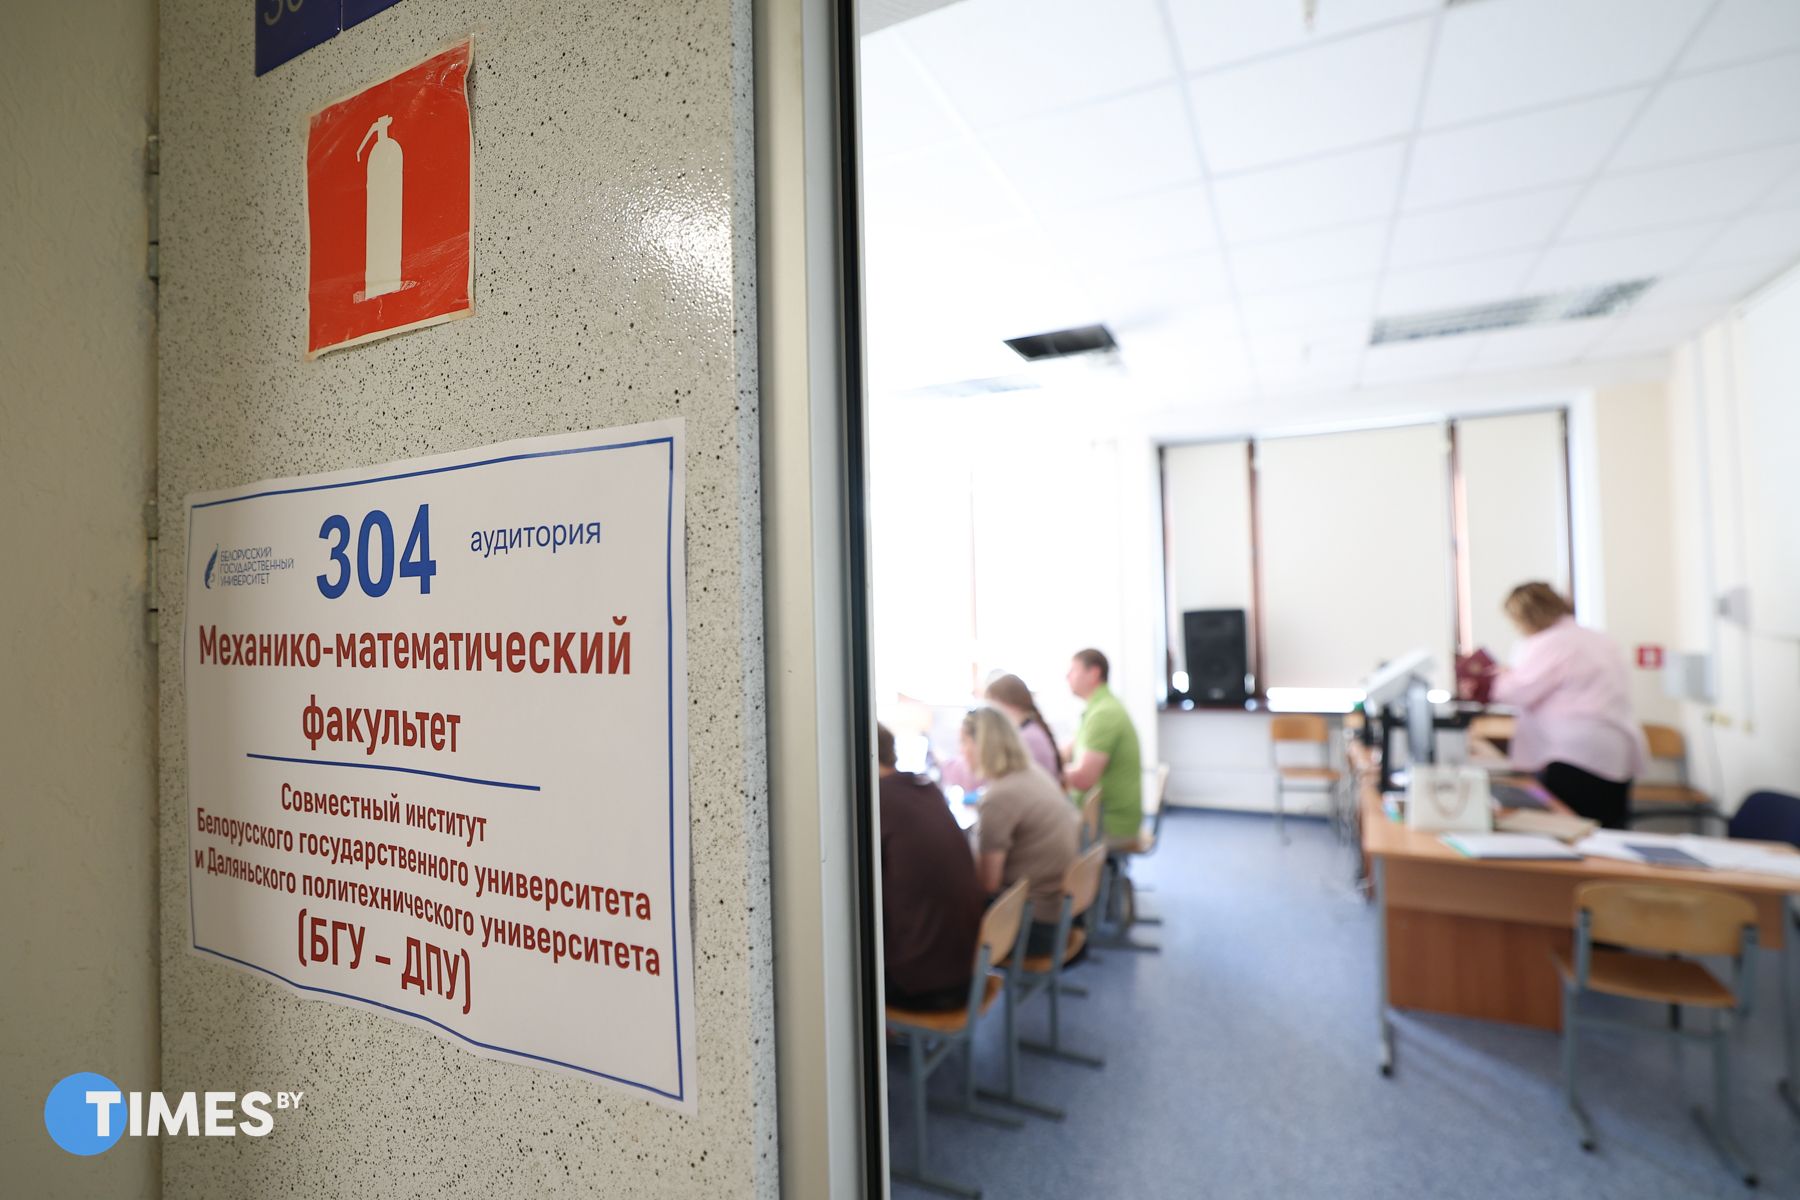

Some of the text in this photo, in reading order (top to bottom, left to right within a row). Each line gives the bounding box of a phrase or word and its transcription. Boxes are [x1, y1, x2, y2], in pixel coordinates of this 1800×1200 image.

[220, 546, 272, 562] БЕЛОРУССКИЙ
[220, 557, 295, 574] ГОСУДАРСТВЕННЫЙ
[316, 503, 437, 599] 304
[470, 521, 602, 556] аудитория
[220, 572, 270, 587] УНИВЕРСИТЕТ
[199, 615, 632, 675] Механико-математический
[302, 694, 461, 755] факультет
[281, 782, 487, 847] Совместный институт
[197, 807, 651, 921] Белорусского государственного университета
[195, 847, 660, 976] и Даляньского политехнического университета
[298, 908, 366, 970] (БГУ
[401, 936, 471, 1014] ДПУ)
